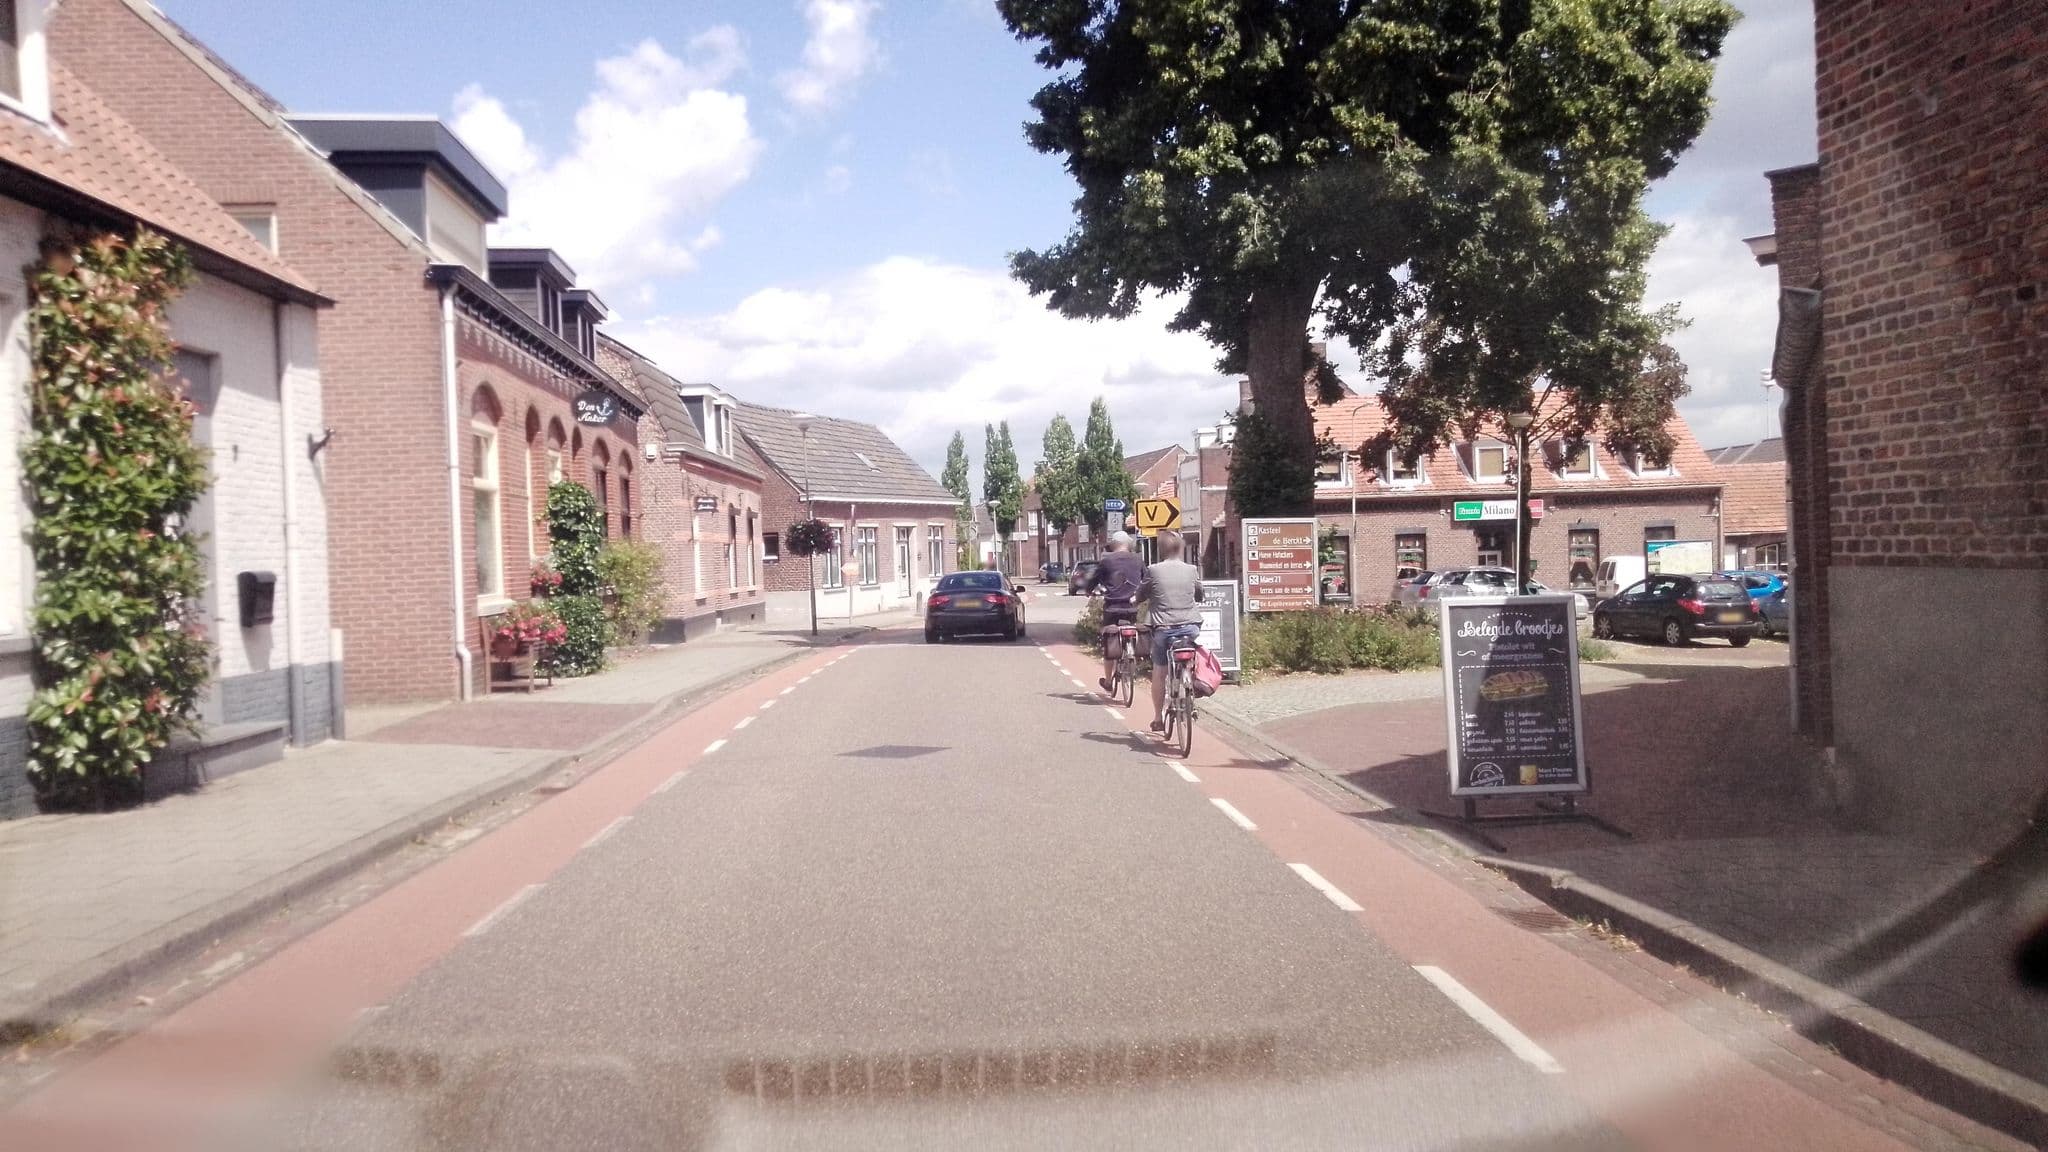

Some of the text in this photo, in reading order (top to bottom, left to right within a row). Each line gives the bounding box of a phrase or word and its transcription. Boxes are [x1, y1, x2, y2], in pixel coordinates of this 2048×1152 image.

[578, 400, 595, 410] Den
[1144, 505, 1158, 521] V
[1484, 506, 1515, 515] Milano
[1457, 619, 1563, 642] Belegde broodjes
[1482, 652, 1491, 660] of
